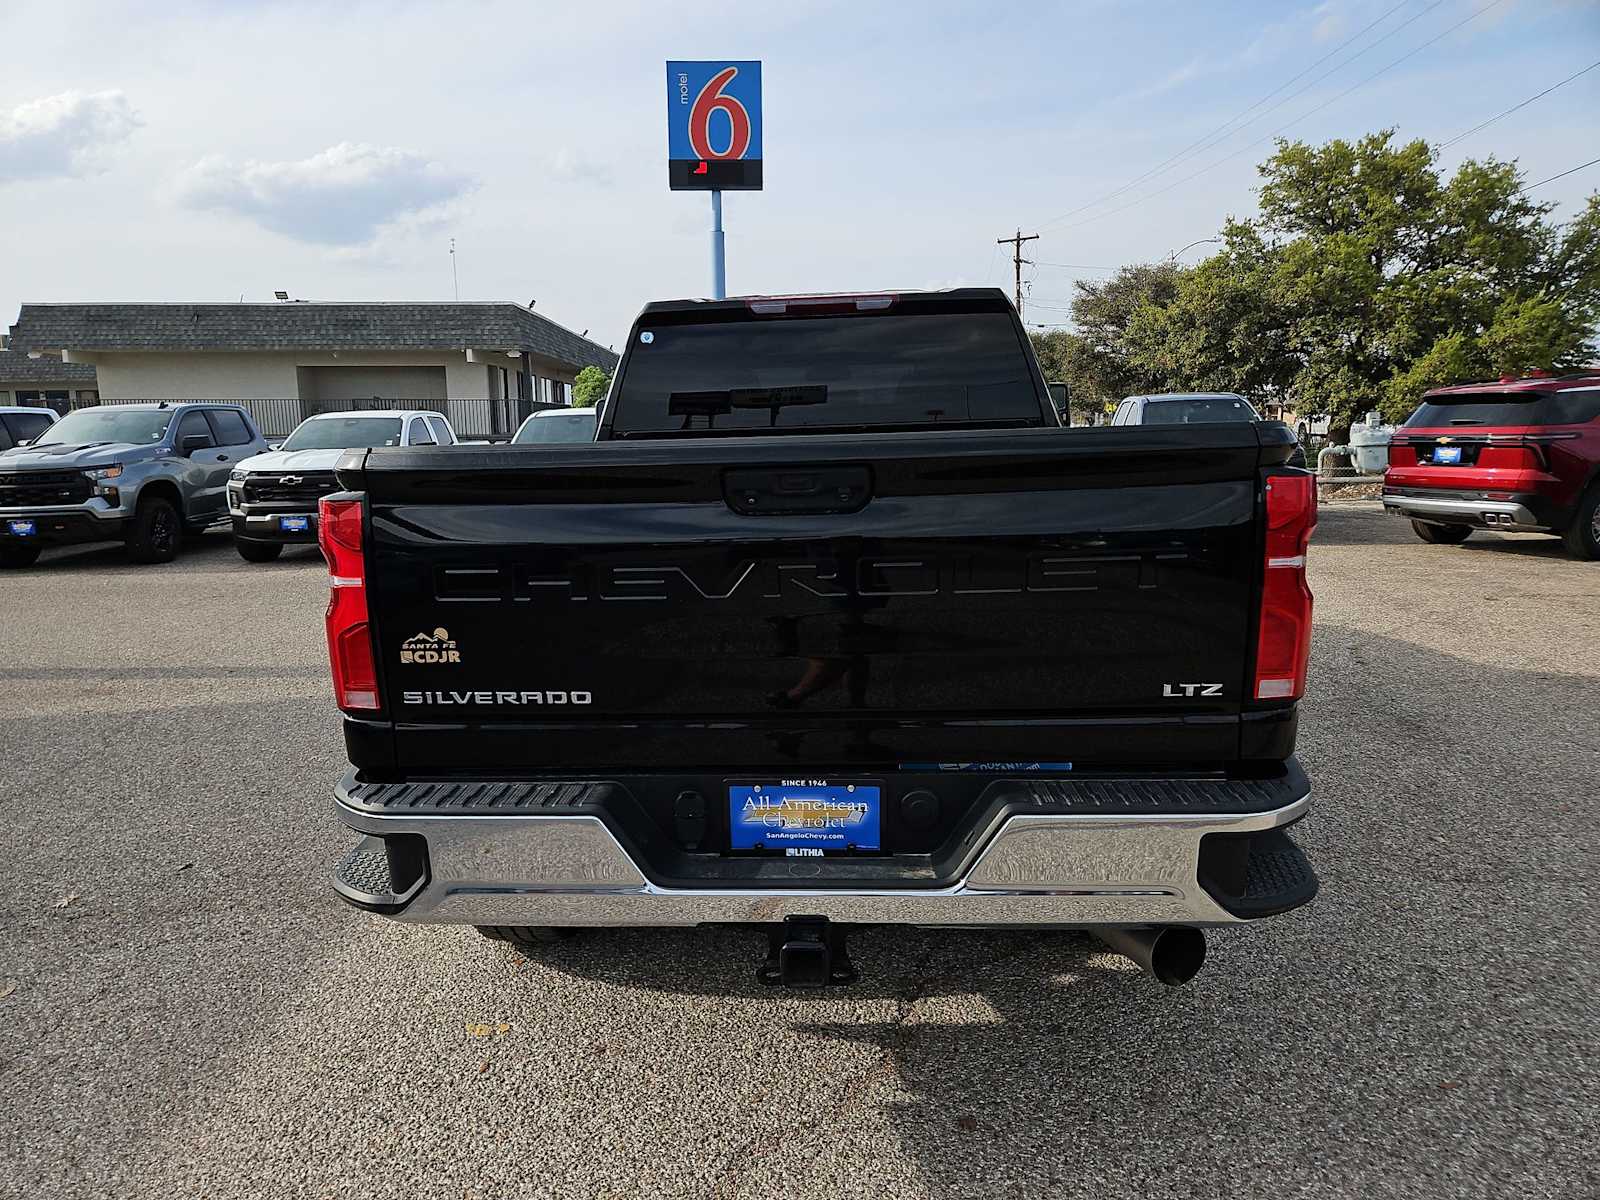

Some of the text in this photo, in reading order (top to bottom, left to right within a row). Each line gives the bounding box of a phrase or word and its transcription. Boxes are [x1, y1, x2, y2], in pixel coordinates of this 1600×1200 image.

[678, 73, 689, 105] motel
[688, 66, 751, 160] 6
[433, 554, 1189, 603] CHEVROLET
[414, 650, 461, 663] CDJR
[1162, 683, 1224, 697] LTZ
[402, 691, 593, 705] SILVERADO
[742, 796, 869, 813] All American
[762, 811, 847, 829] Chevrolet
[766, 832, 845, 841] SanAngeloChevy.com
[794, 848, 824, 857] LITHIA
